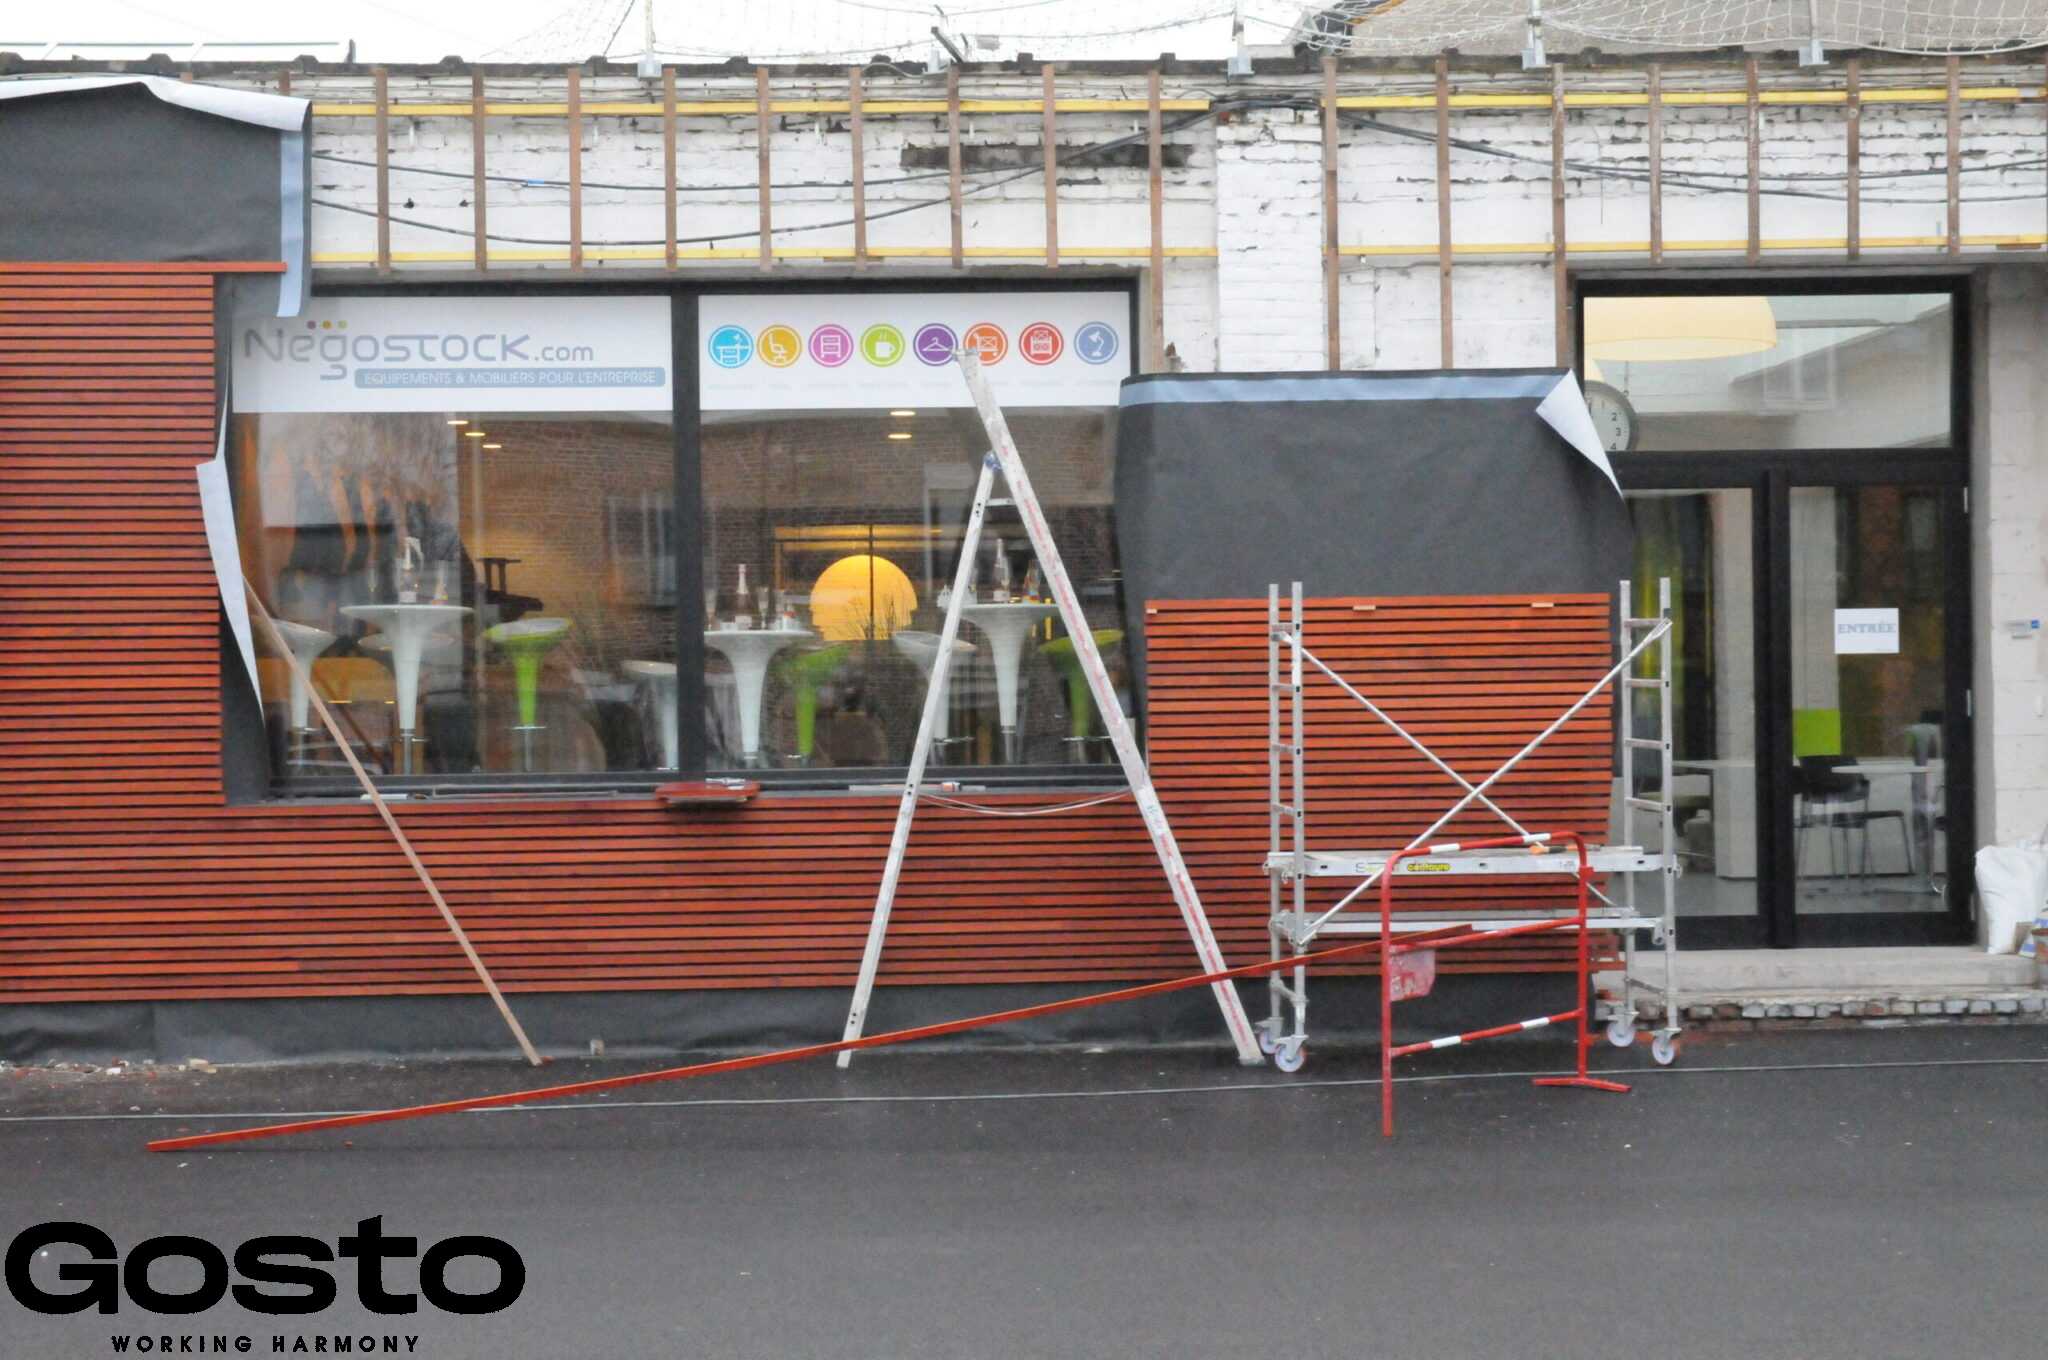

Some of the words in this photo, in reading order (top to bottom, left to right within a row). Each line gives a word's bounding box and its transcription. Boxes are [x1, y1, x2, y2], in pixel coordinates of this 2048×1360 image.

[364, 372, 452, 385] EQUIPEMENTS
[455, 372, 465, 384] &
[469, 371, 536, 384] MOBILIERS
[538, 371, 574, 383] POUR
